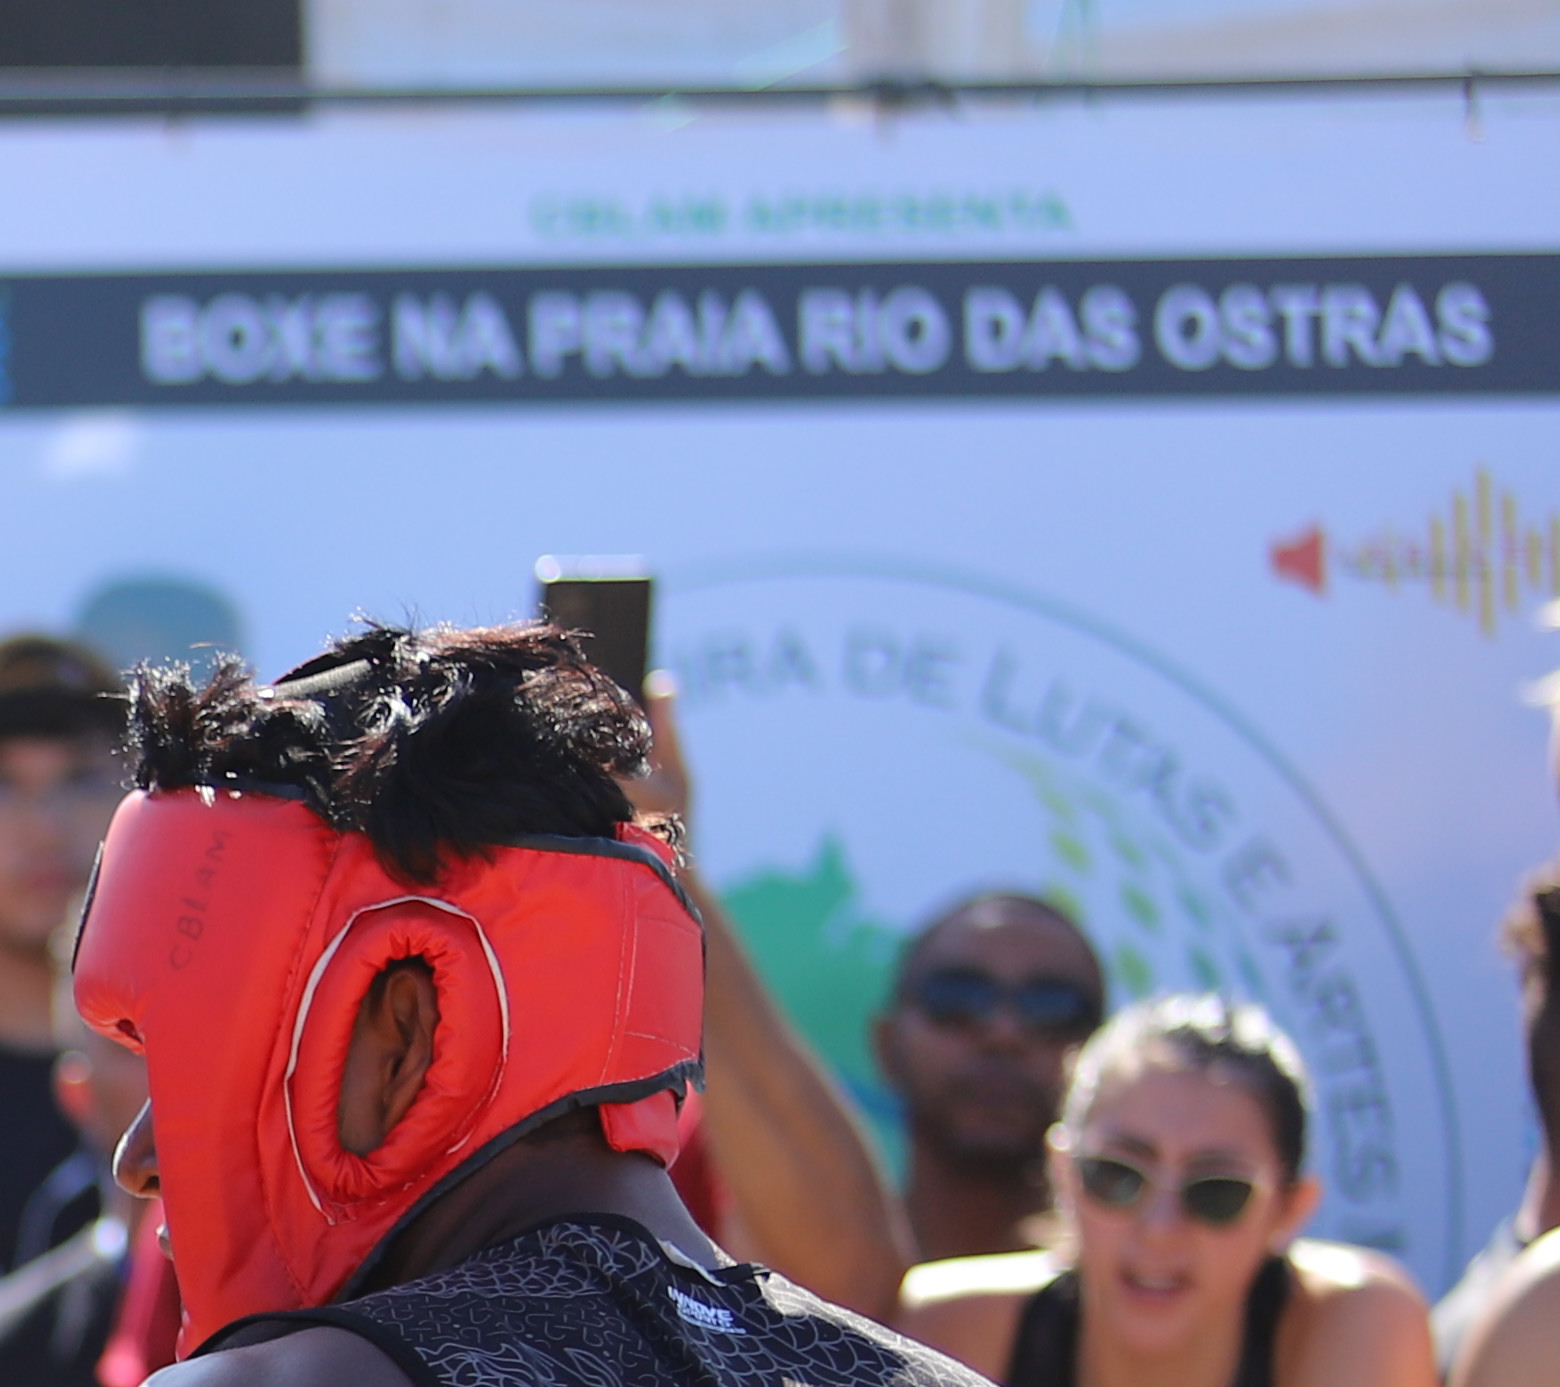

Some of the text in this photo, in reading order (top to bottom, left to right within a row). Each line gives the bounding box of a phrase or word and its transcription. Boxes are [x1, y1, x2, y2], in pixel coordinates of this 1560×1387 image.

[138, 279, 1495, 384] BOXE NA PRAIA RIO DAS OSTRAS
[980, 645, 1236, 856] LUTAS
